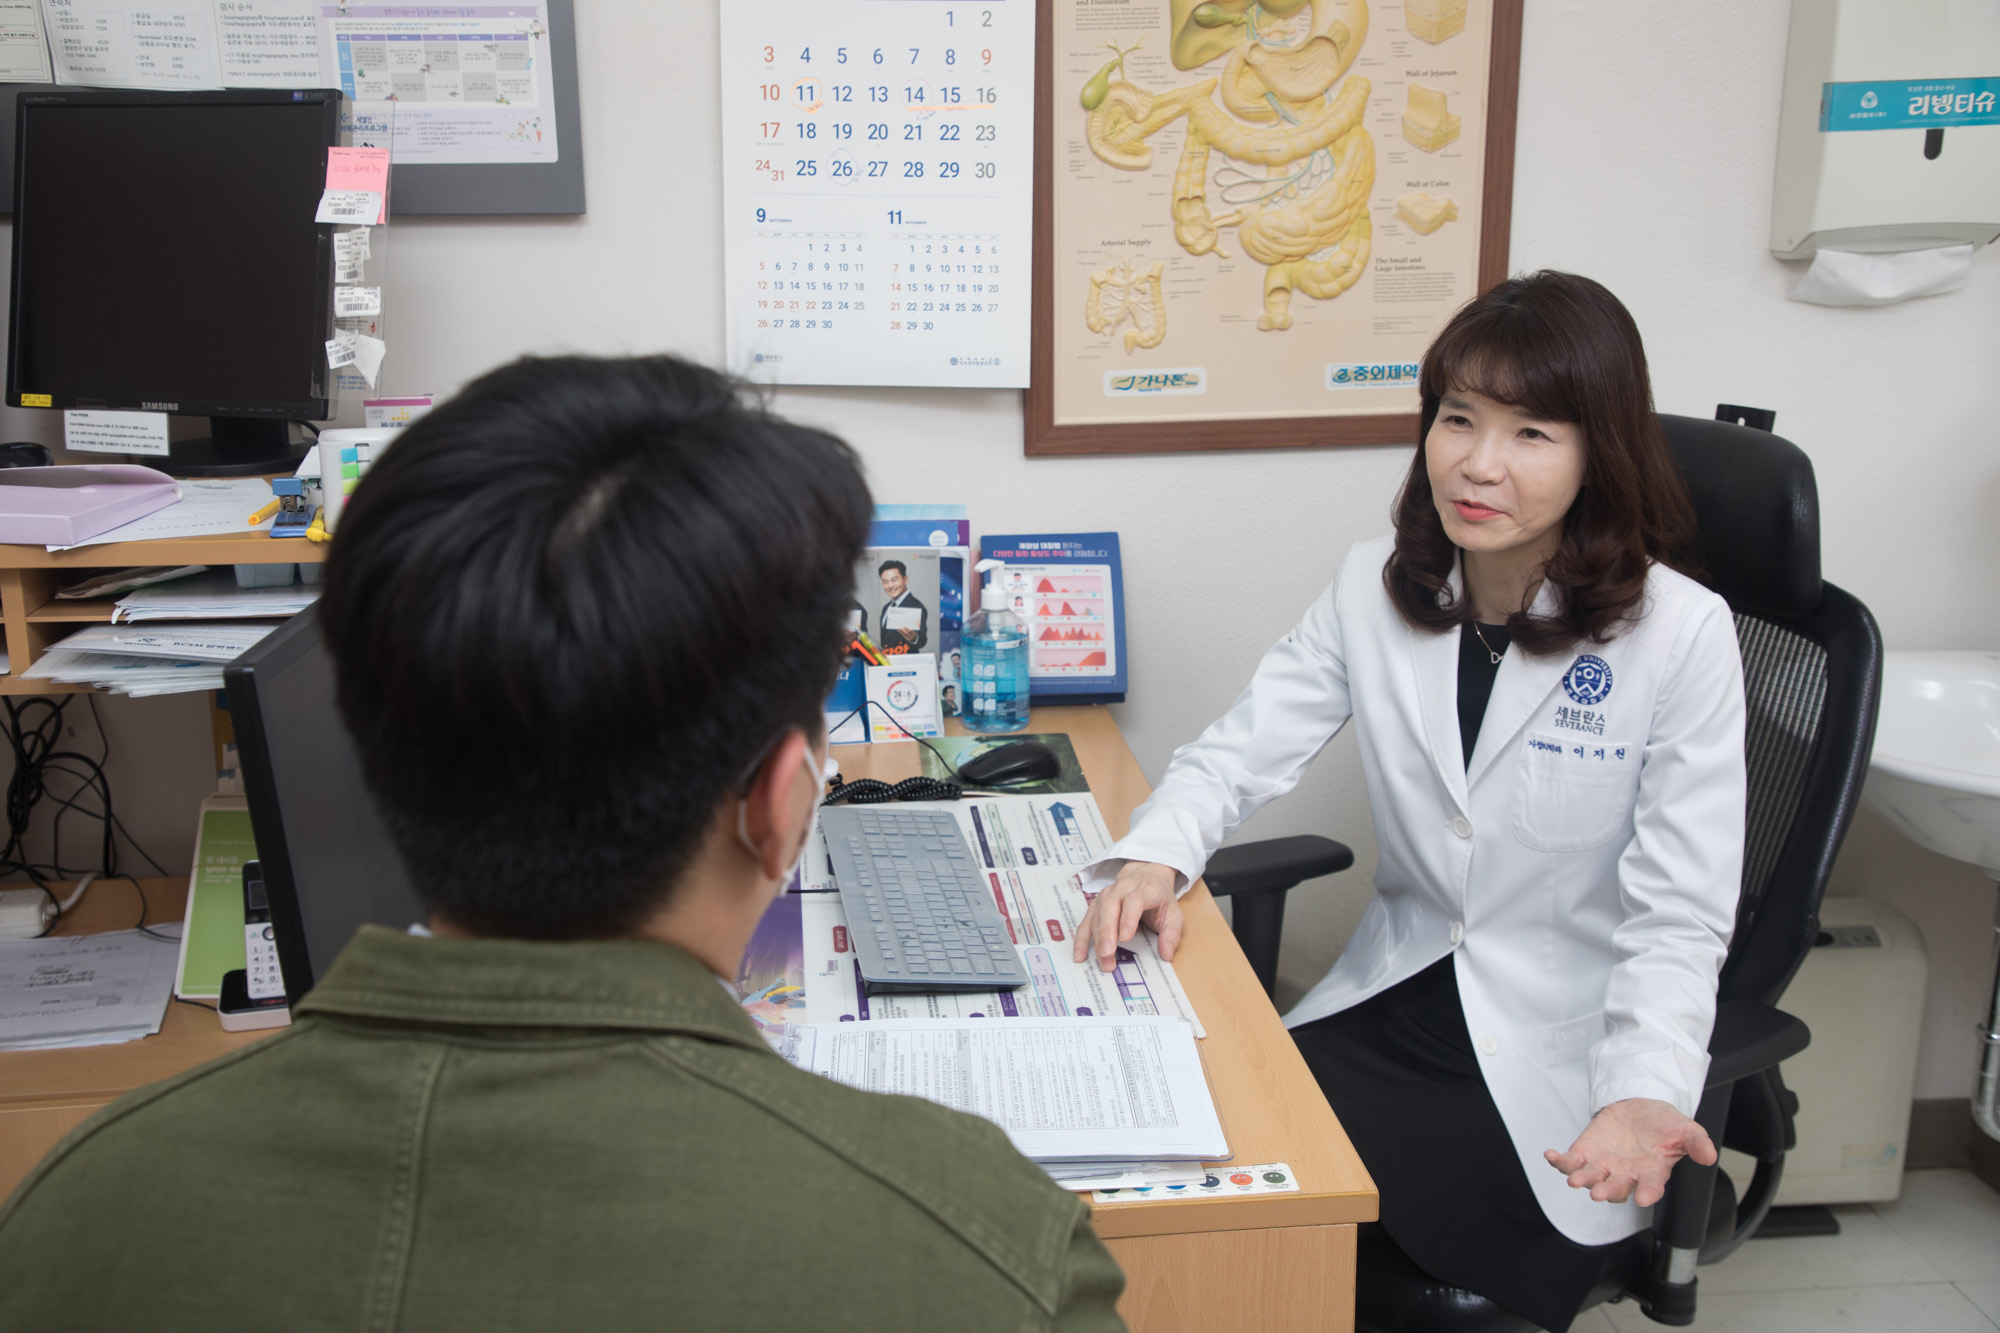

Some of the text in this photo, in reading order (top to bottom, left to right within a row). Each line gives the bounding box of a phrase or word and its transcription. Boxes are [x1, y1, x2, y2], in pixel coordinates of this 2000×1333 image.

[946, 10, 993, 28] 1 2
[763, 45, 992, 66] 3 4 5 6 7 8 9
[759, 83, 997, 104] 10 11 12 13 14 15 16
[1908, 91, 1996, 116] 리빙티슈
[760, 121, 996, 142] 17 18 19 20 21 22 23
[755, 159, 996, 182] 24 31 25 26 27 28 29 30
[756, 207, 767, 223] 9
[887, 209, 902, 225] 11
[824, 244, 830, 252] 2
[840, 244, 847, 252] 3
[1127, 239, 1151, 248] Supply
[925, 245, 932, 253] 2
[941, 245, 949, 253] 3
[975, 246, 981, 254] 5
[991, 246, 997, 254] 6
[759, 262, 766, 270] 5
[791, 262, 798, 270] 7
[807, 263, 814, 271] 8
[838, 263, 848, 271] 10
[893, 264, 900, 272] 7
[909, 264, 916, 272] 8
[925, 264, 932, 272] 9
[972, 265, 982, 273] 12
[988, 265, 999, 273] 13
[757, 281, 767, 289] 12
[773, 281, 783, 289] 13
[805, 282, 816, 290] 15
[822, 282, 832, 290] 16
[838, 282, 848, 290] 17
[854, 283, 864, 291] 18
[923, 284, 933, 292] 16
[955, 284, 966, 292] 18
[972, 284, 982, 292] 19
[987, 284, 999, 293] 20
[757, 300, 768, 308] 19
[773, 301, 784, 309] 20
[789, 301, 799, 309] 21
[805, 301, 816, 309] 22
[821, 301, 832, 309] 23
[853, 302, 865, 310] 25
[890, 302, 900, 310] 21
[922, 303, 933, 311] 23
[939, 303, 949, 311] 24
[955, 303, 966, 311] 25
[987, 304, 998, 312] 27
[789, 320, 800, 328] 28
[805, 320, 816, 328] 29
[821, 320, 832, 328] 30
[890, 322, 933, 330] 28 29 30
[1353, 364, 1418, 381] 중외제약
[1137, 374, 1184, 387] 가나톤
[141, 402, 179, 411] SAMSUNG
[1555, 706, 1606, 727] 세브란스
[1555, 719, 1604, 736] SEVERANCE
